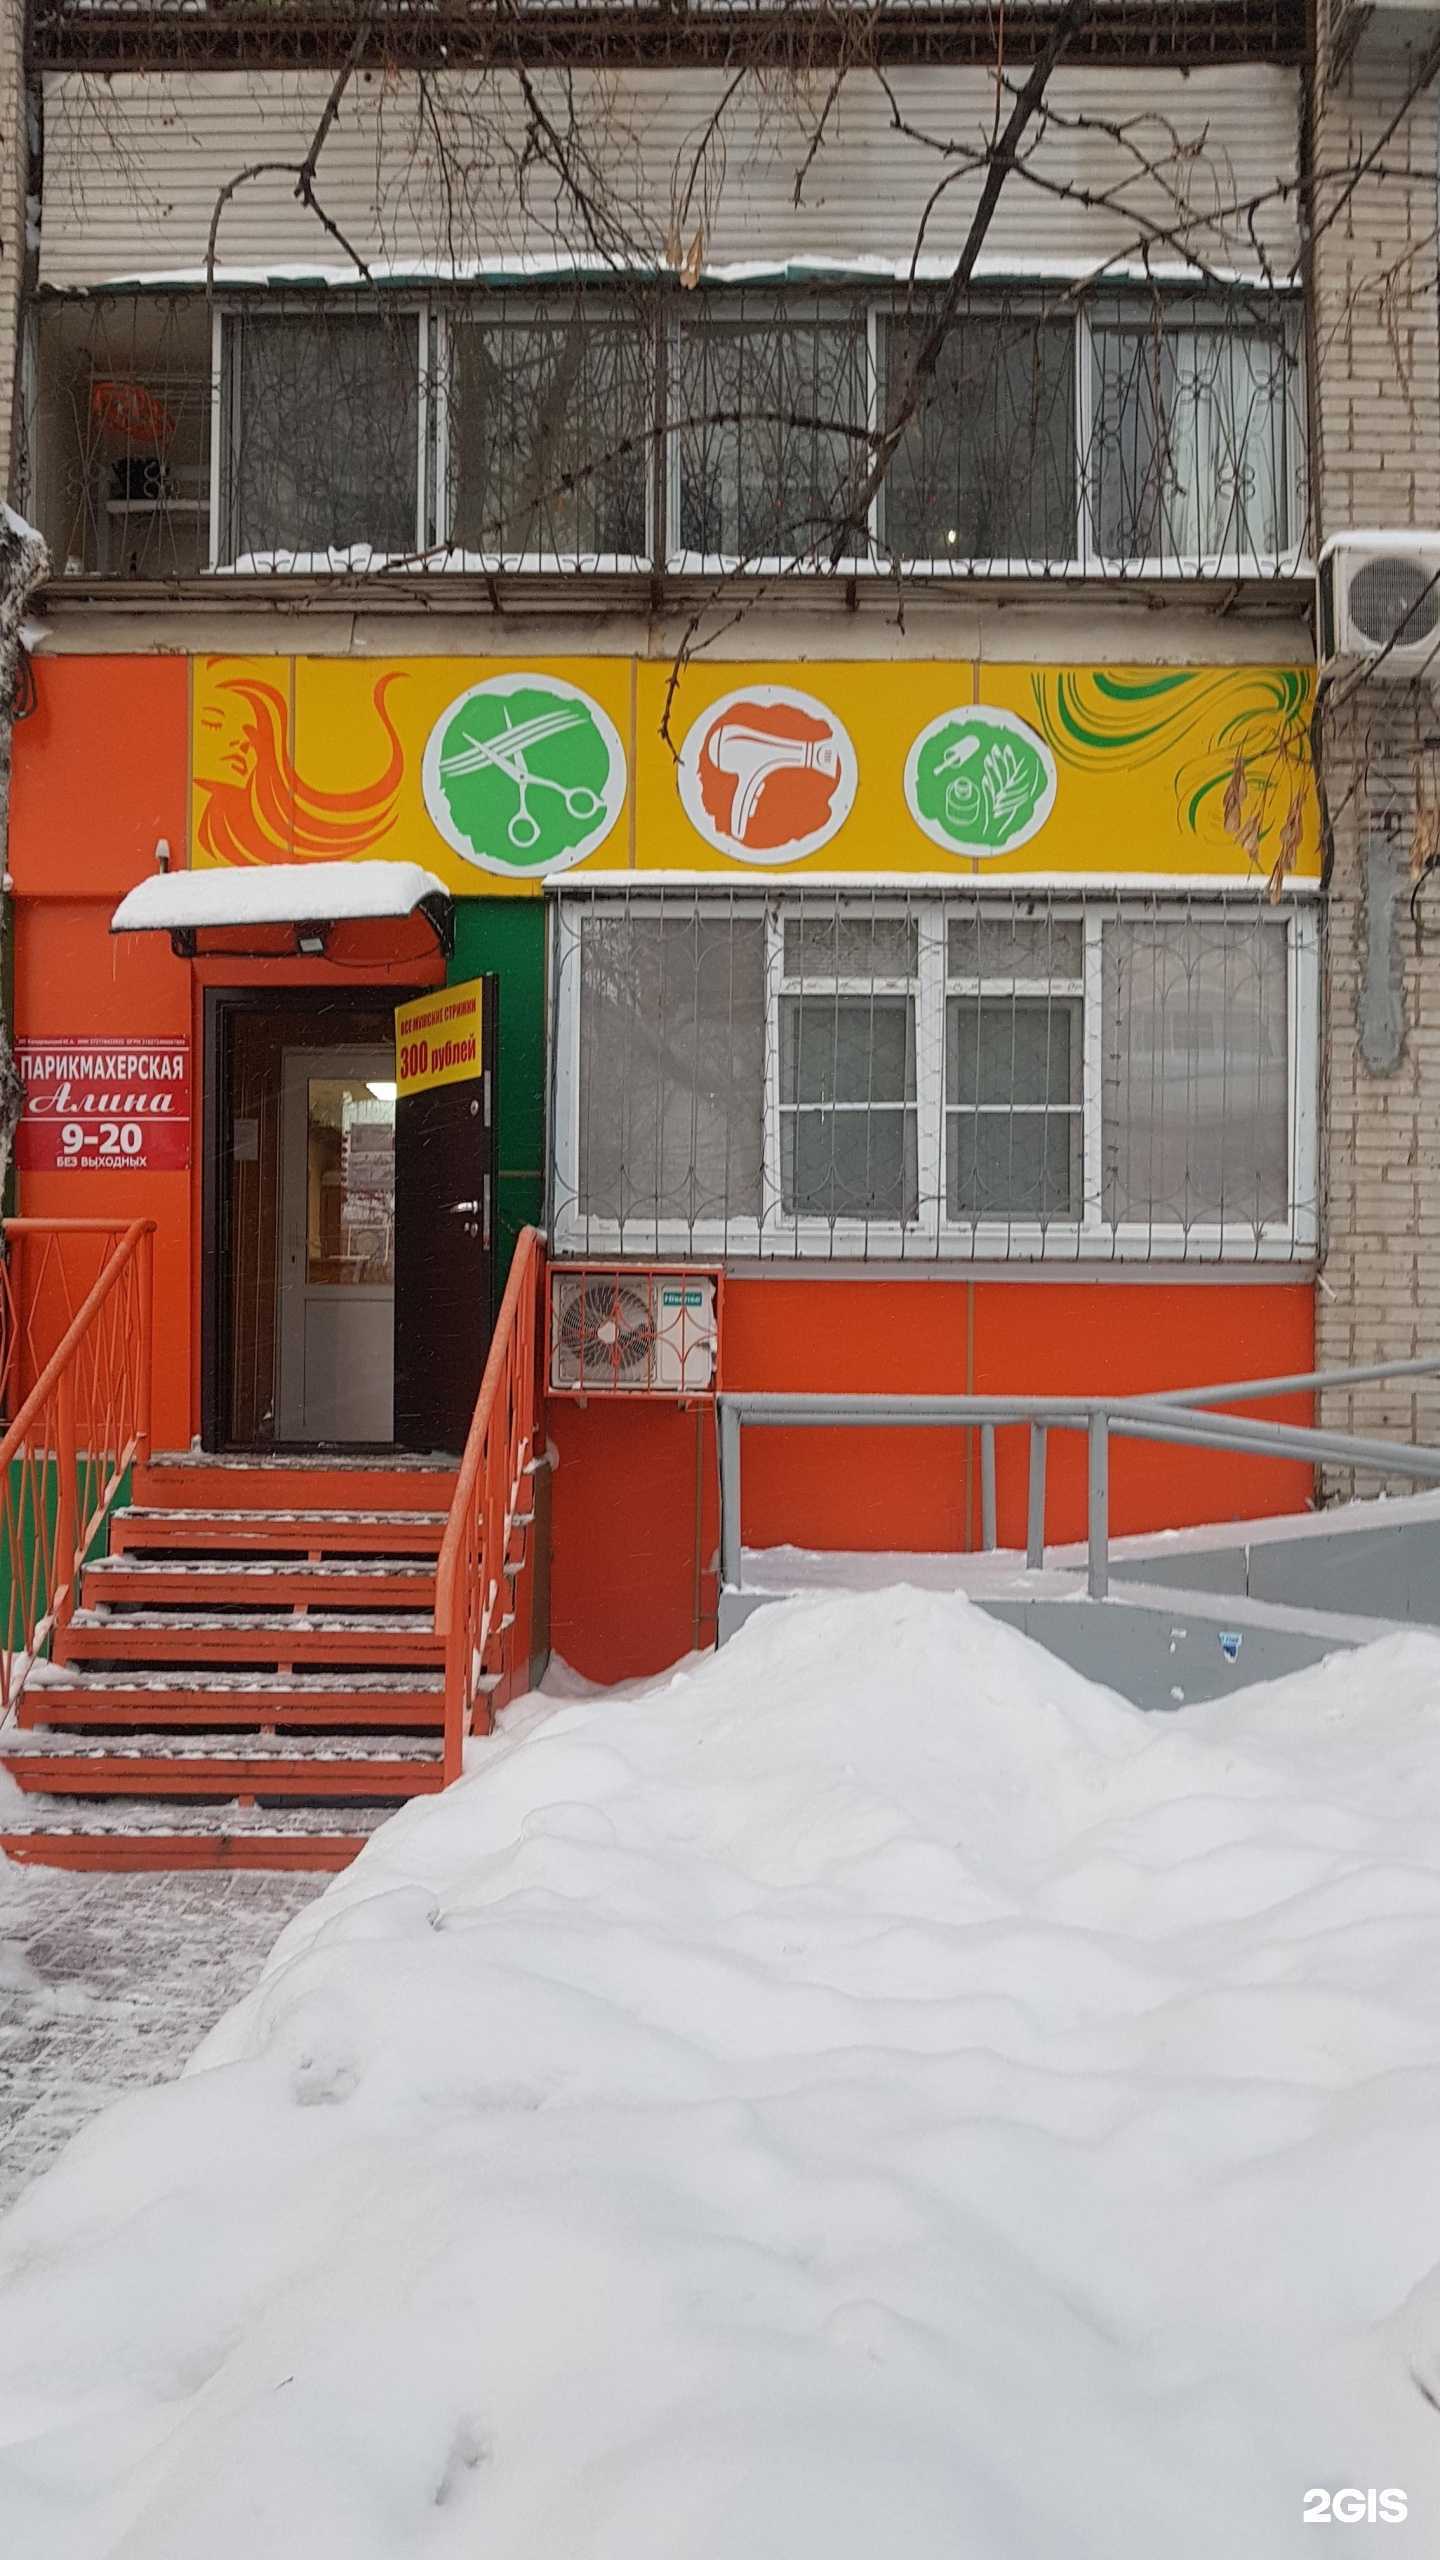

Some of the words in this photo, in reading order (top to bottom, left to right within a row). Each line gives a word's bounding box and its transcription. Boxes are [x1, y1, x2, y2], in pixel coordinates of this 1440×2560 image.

[444, 998, 476, 1021] СТРИЖКИ
[21, 1055, 183, 1081] ПАРИКМАХЕРСКАЯ
[400, 1040, 428, 1079] 300
[431, 1033, 476, 1074] рублей
[28, 1082, 174, 1113] Алина
[61, 1123, 143, 1155] 9-20
[56, 1157, 78, 1167] БЕЗ
[81, 1156, 147, 1169] ВЫХОДНЫХ
